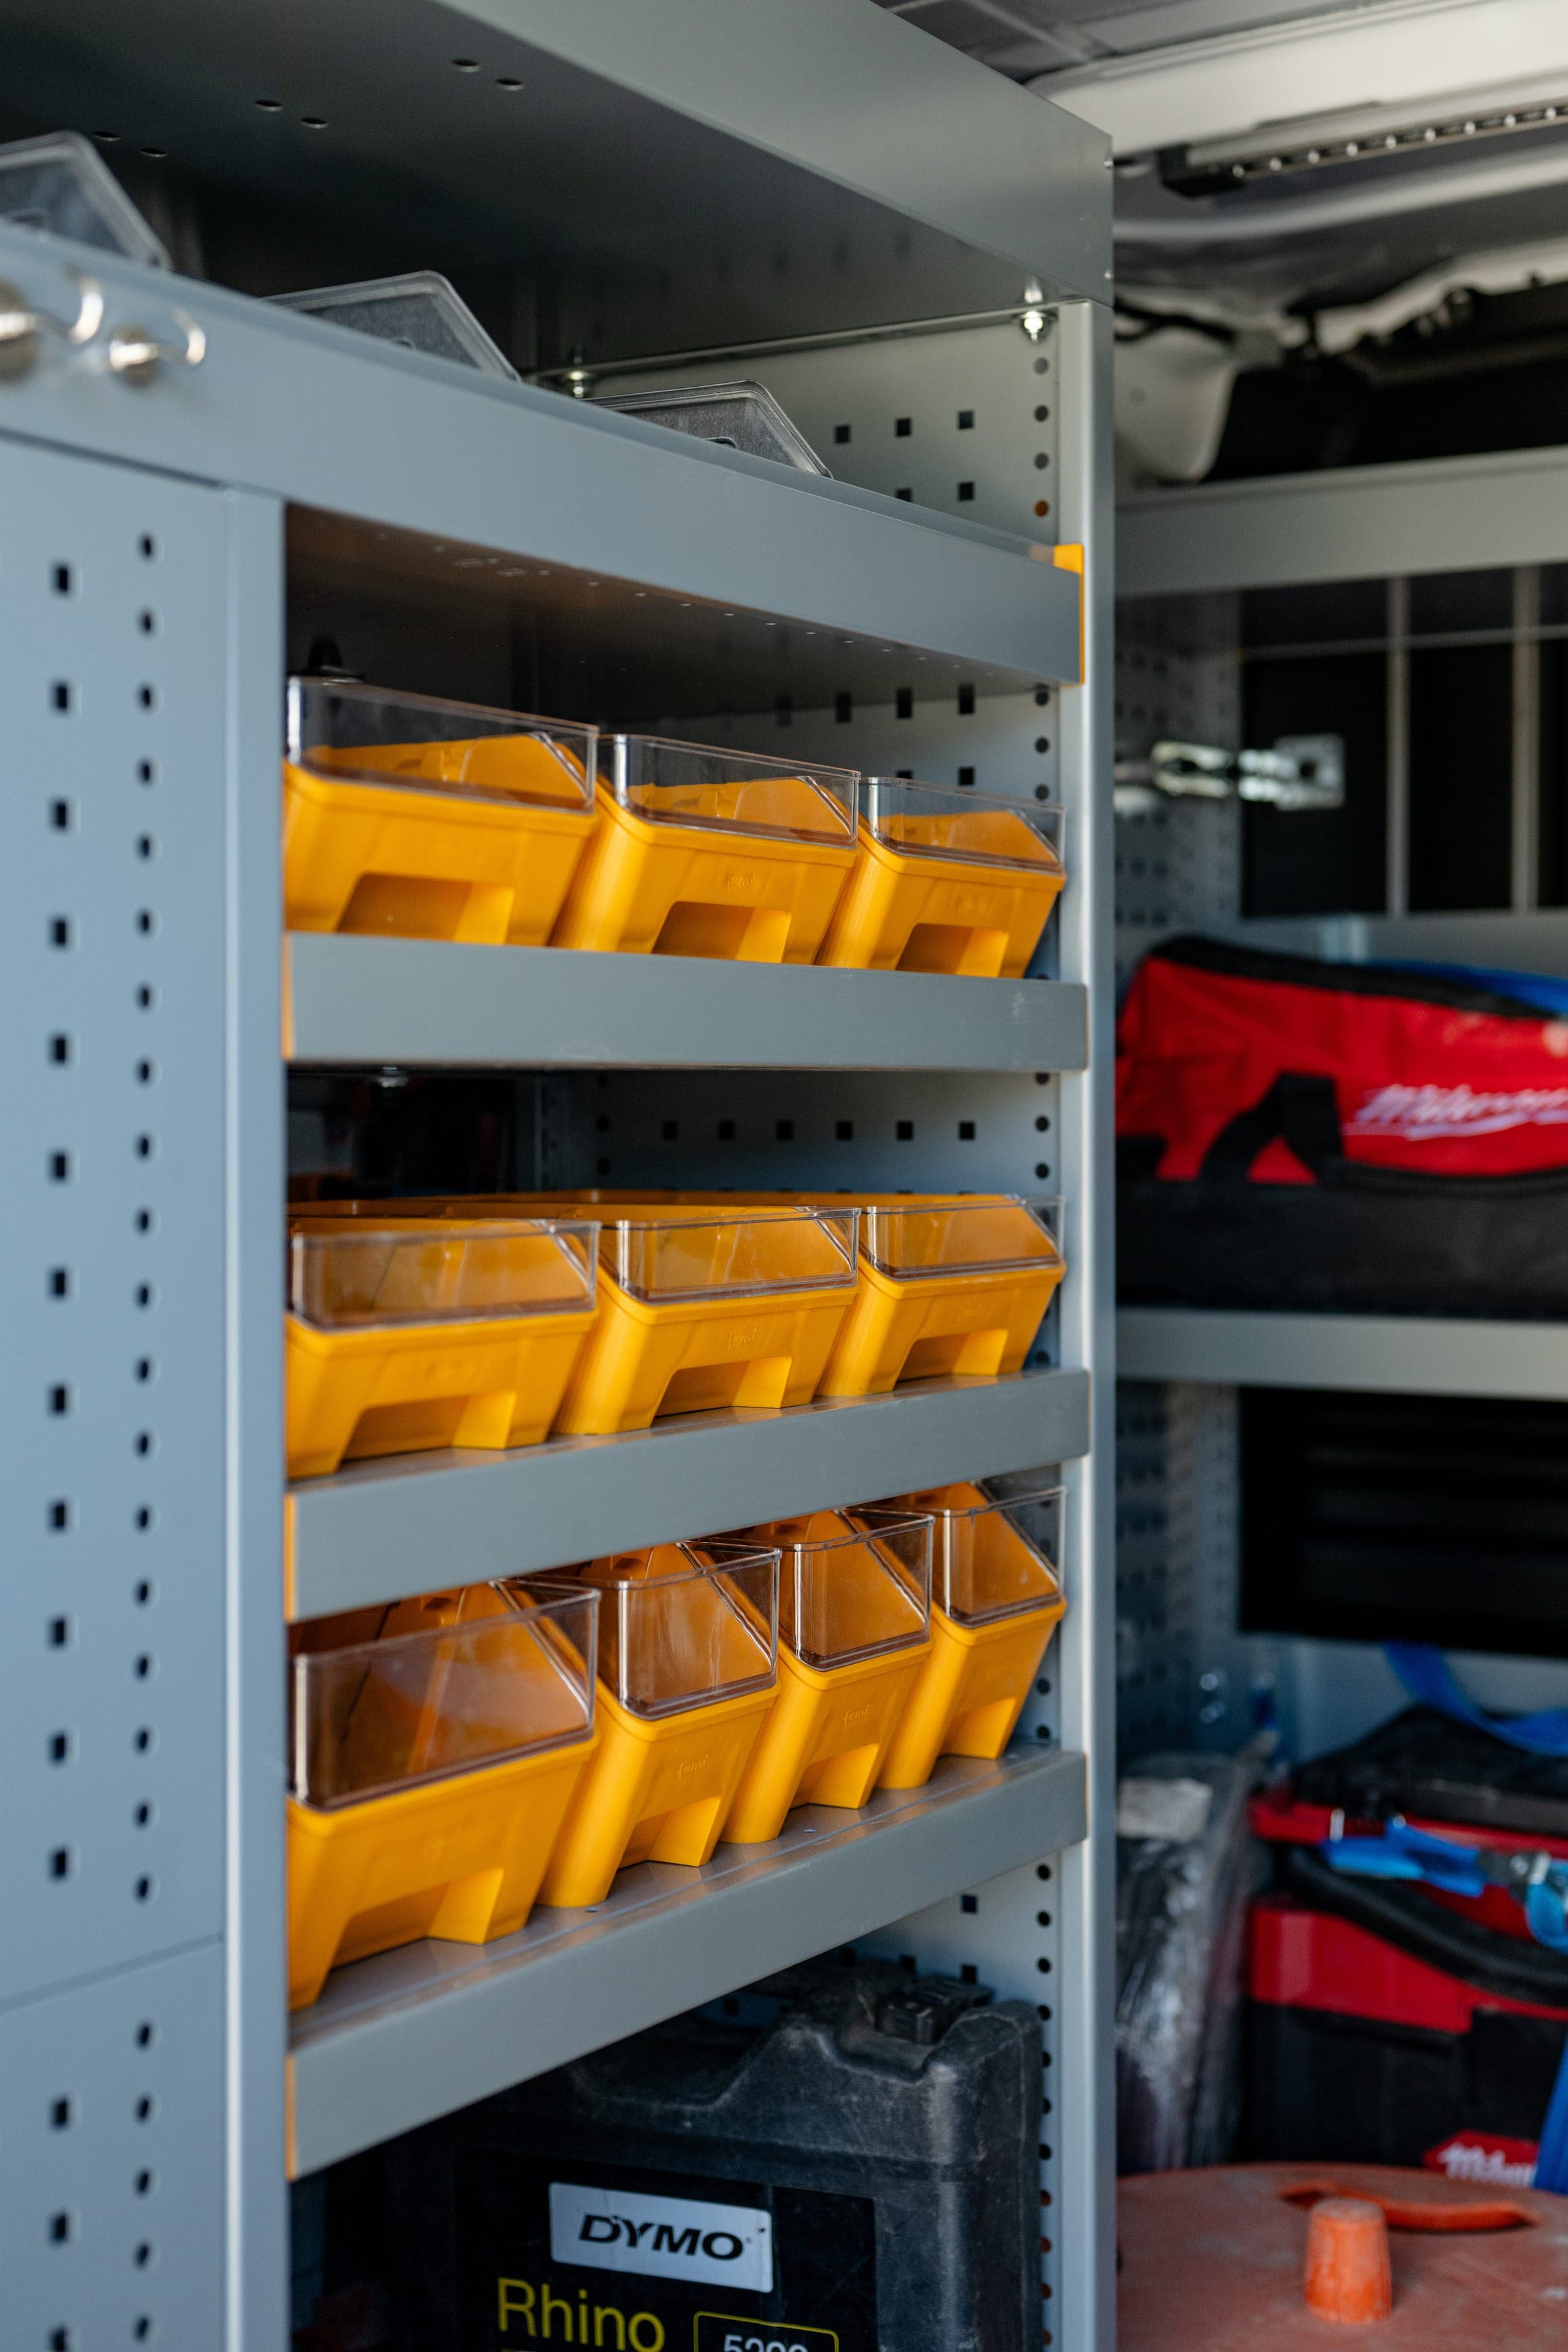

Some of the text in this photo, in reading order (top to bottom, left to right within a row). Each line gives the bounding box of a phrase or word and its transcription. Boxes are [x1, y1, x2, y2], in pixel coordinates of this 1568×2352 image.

[578, 2213, 744, 2261] DYMO
[497, 2276, 665, 2352] Rhino
[723, 2334, 808, 2352] 52
